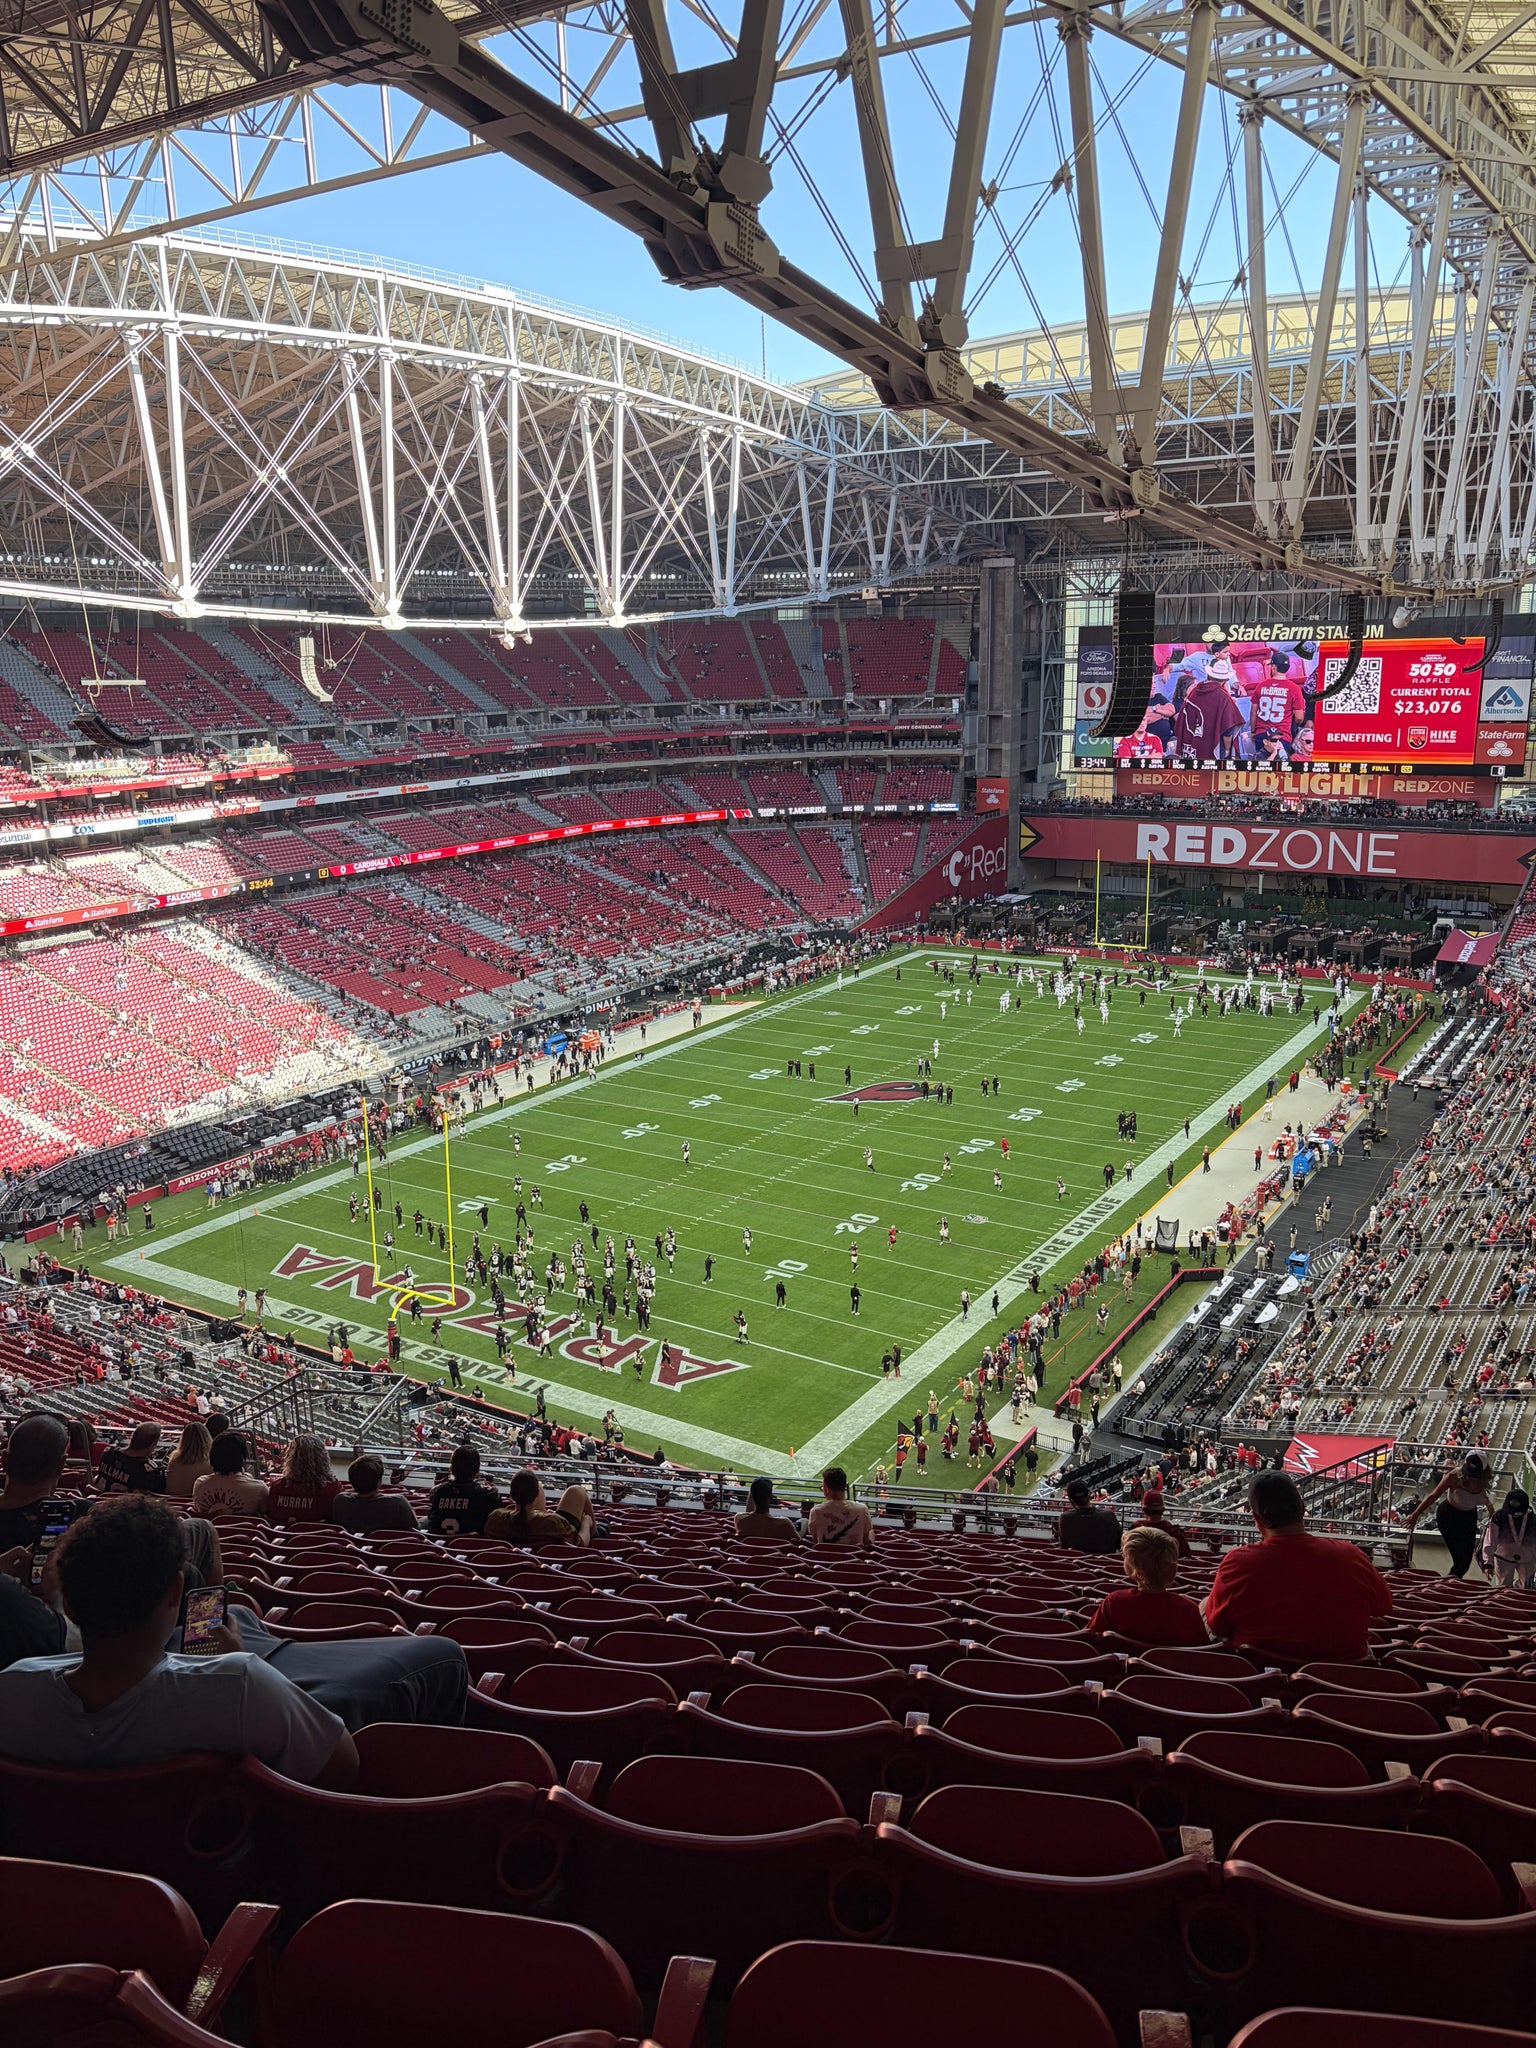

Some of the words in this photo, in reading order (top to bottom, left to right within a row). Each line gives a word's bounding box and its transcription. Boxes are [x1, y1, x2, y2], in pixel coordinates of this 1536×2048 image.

[1316, 624, 1384, 639] STADUM
[1087, 652, 1106, 662] Ford
[1409, 664, 1432, 676] 50
[1432, 663, 1456, 676] 50
[1391, 688, 1436, 696] CURRENT
[1257, 697, 1287, 723] 85
[1394, 700, 1461, 716] $23,076
[1327, 733, 1392, 742] BENEFITING
[1430, 730, 1456, 739] HIKE
[1081, 758, 1106, 768] 33:44
[1132, 774, 1199, 786] REDZONE
[1218, 771, 1278, 793] BUD
[1284, 772, 1373, 795] LIGHT
[1393, 780, 1475, 794] REDZONE
[788, 806, 827, 815] T.MCBRIDE
[73, 825, 95, 835] COX
[1136, 824, 1400, 875] REDZONE
[354, 858, 388, 870] CARDINALS
[971, 837, 1007, 881] Red
[340, 865, 346, 874] 0
[249, 878, 274, 890] 33:44
[166, 891, 201, 902] FALCONS
[212, 888, 218, 896] 0
[748, 1068, 782, 1080] 50
[688, 1094, 722, 1107] 40
[1007, 1108, 1043, 1122] 50
[621, 1122, 660, 1137] 30
[959, 1138, 995, 1154] 40
[545, 1154, 587, 1171] 20
[178, 1168, 220, 1187] ARIZONA
[900, 1173, 942, 1191] 30
[457, 1195, 499, 1210] 10
[835, 1213, 880, 1233] 20
[1006, 1238, 1073, 1284] INSPIRE
[1063, 1197, 1122, 1236] CHANGE
[764, 1259, 808, 1279] 10
[281, 1308, 317, 1324] US
[277, 1495, 313, 1508] MURRAY
[439, 1498, 469, 1510] BAKER
